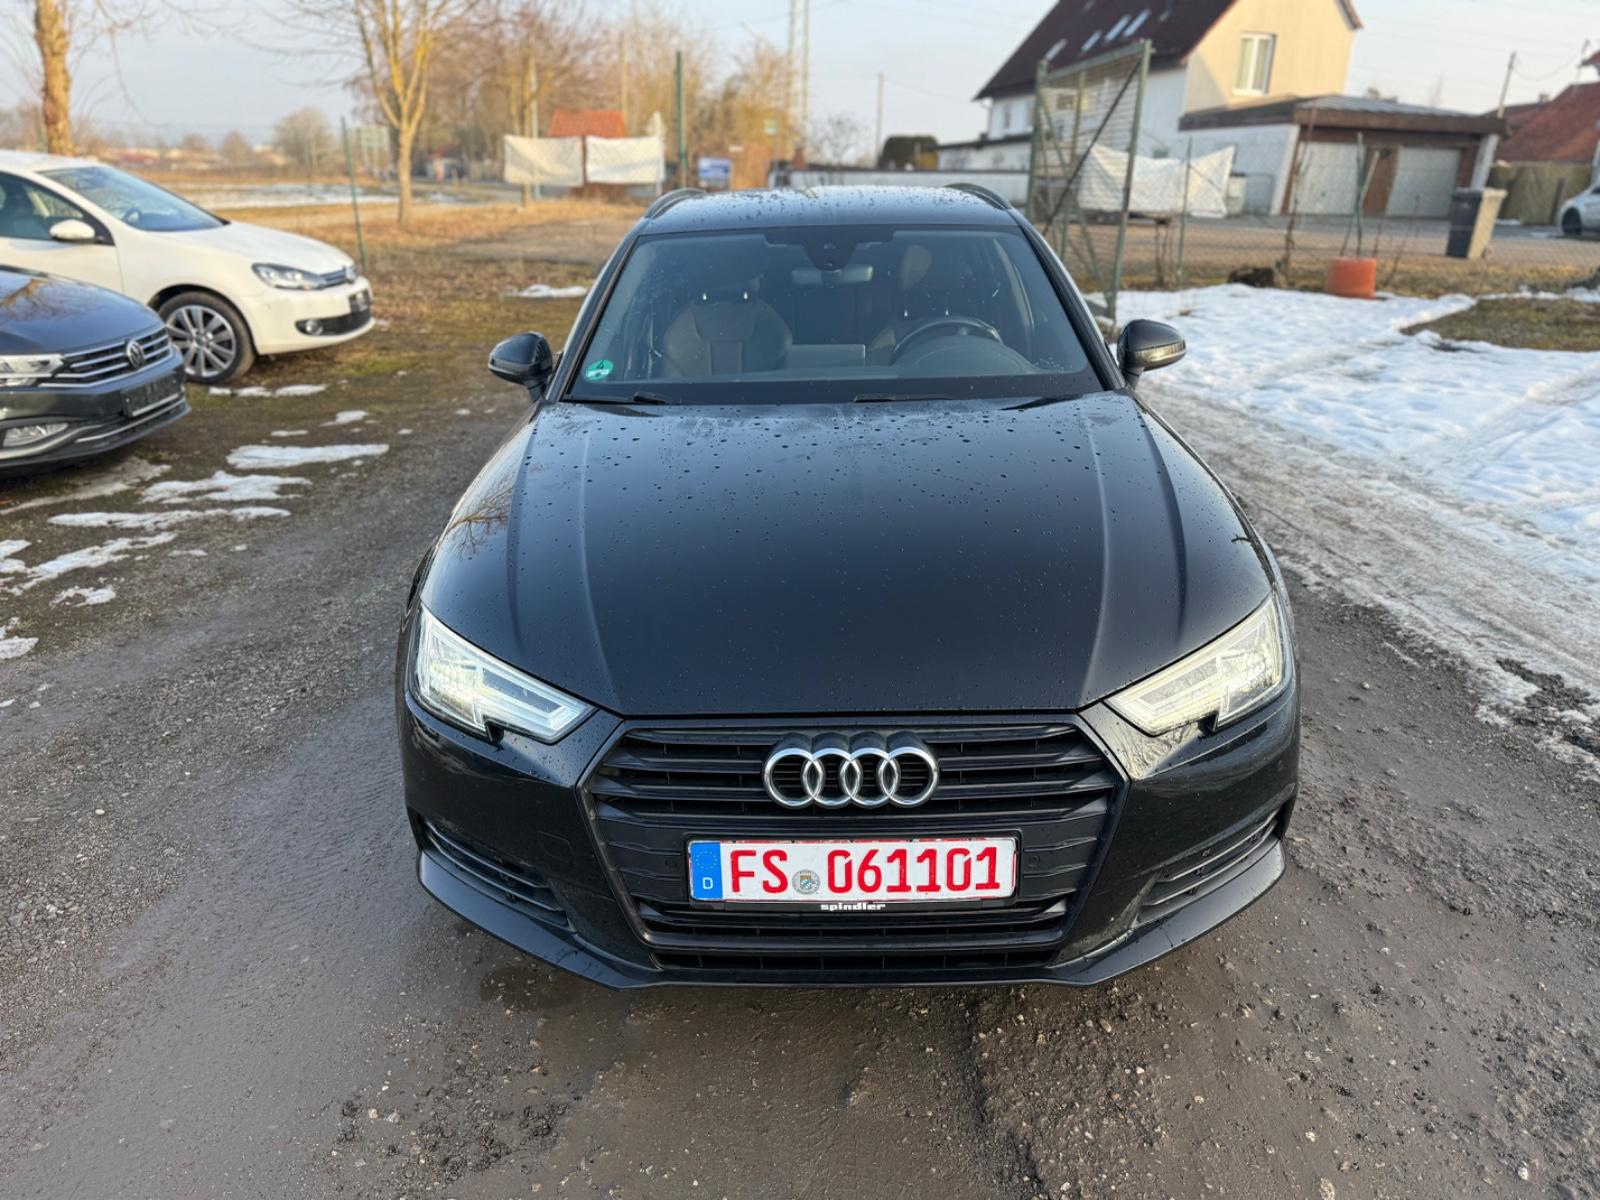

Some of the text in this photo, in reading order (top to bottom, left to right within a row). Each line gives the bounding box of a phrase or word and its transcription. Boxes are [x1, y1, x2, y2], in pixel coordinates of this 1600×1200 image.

[730, 847, 1000, 893] FS 061101
[702, 877, 714, 889] D
[820, 902, 886, 912] spindler
